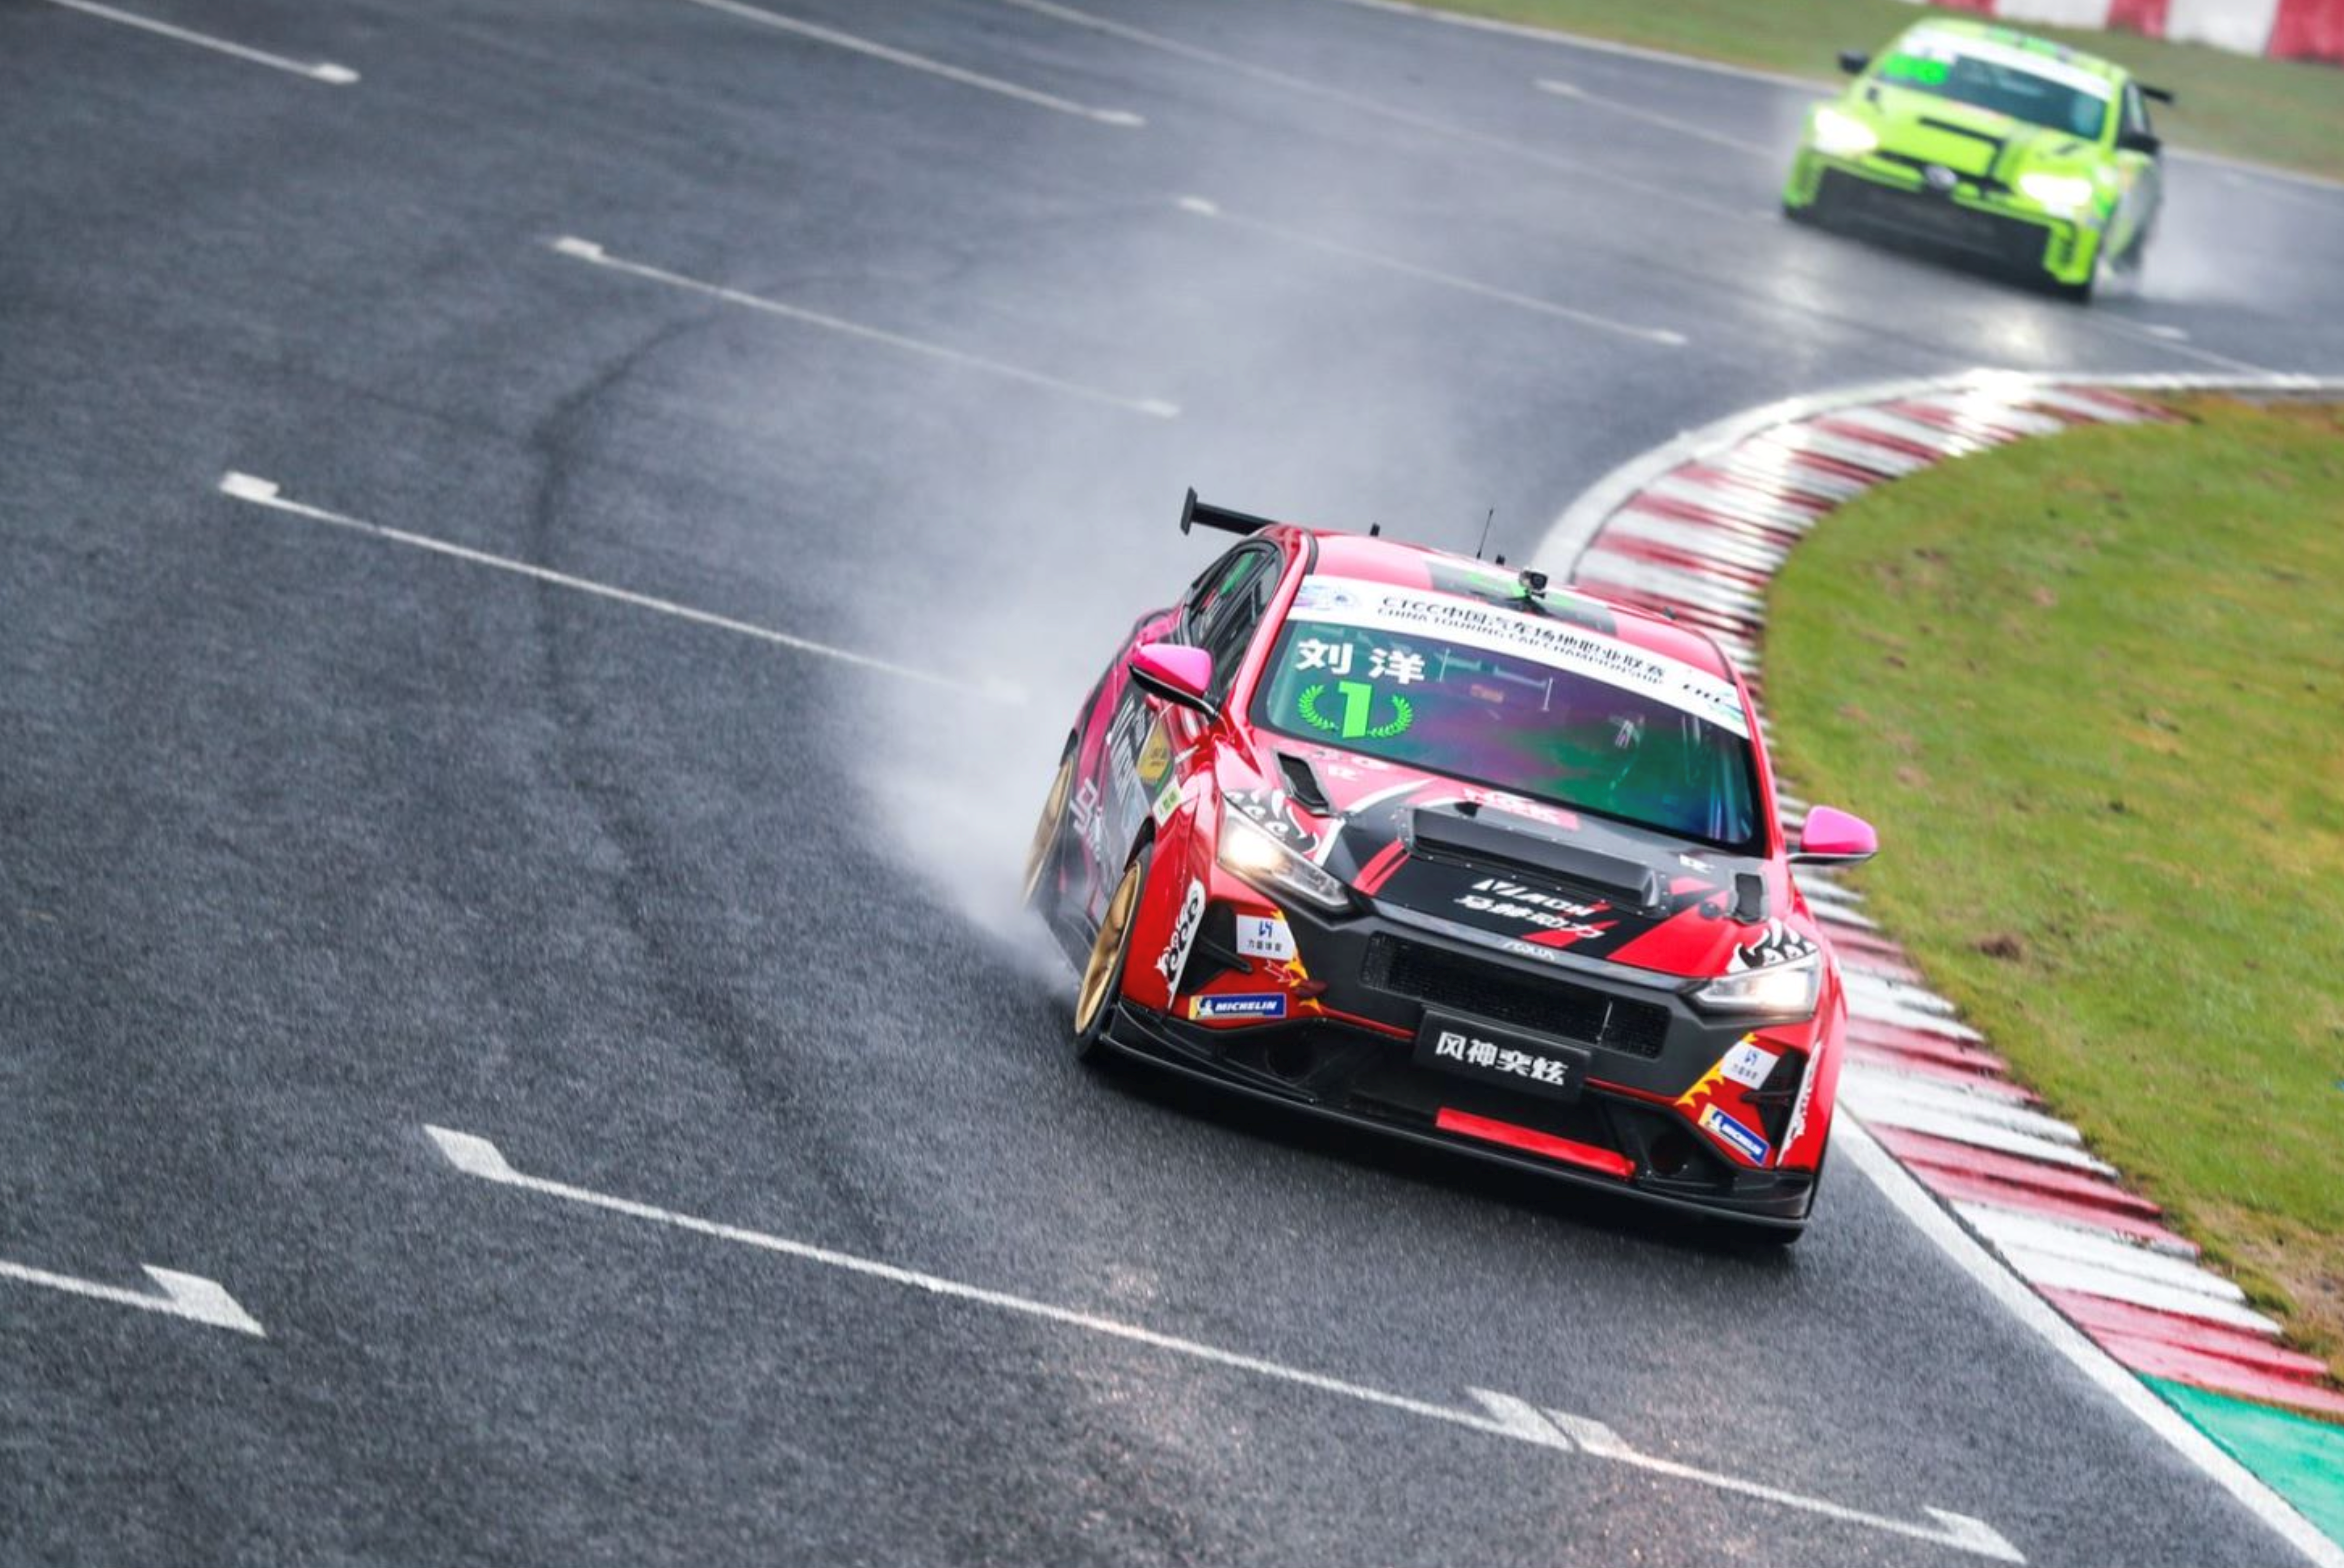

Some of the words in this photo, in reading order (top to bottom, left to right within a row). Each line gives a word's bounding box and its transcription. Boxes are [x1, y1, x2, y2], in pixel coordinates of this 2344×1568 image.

[1378, 607, 1428, 623] CHINA
[1338, 680, 1372, 738] 1
[1214, 1001, 1278, 1012] MICHELIN
[1435, 1031, 1569, 1086] 风神奕炫
